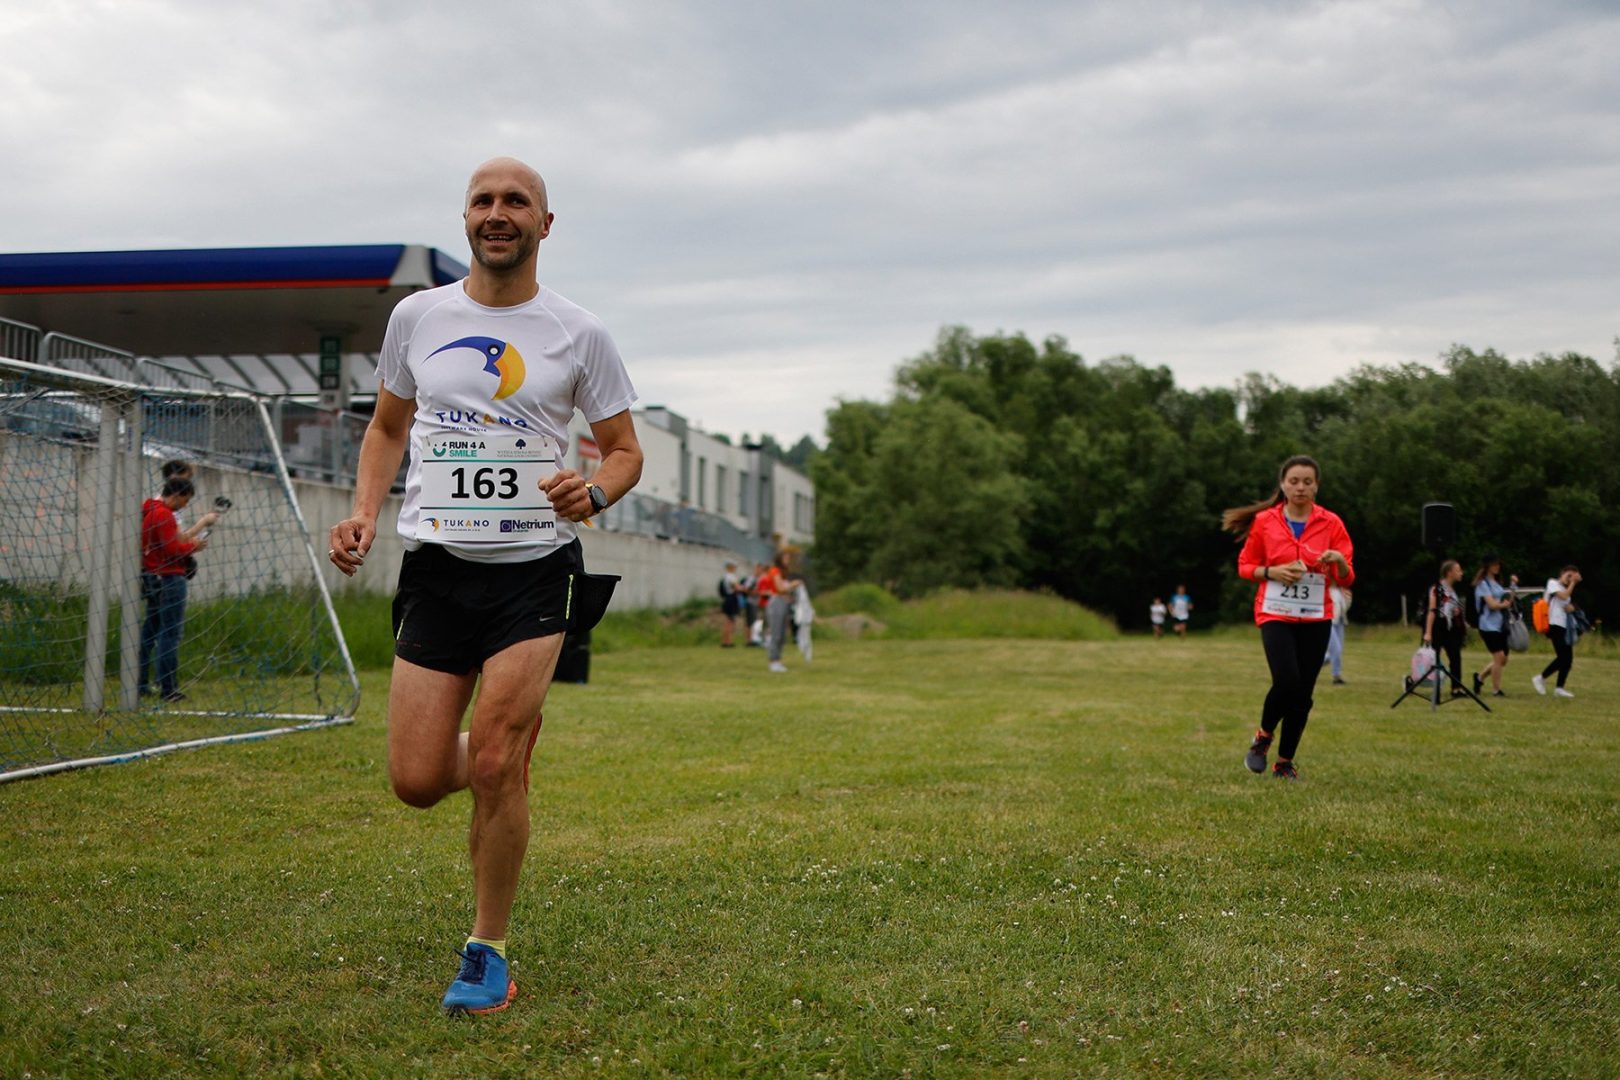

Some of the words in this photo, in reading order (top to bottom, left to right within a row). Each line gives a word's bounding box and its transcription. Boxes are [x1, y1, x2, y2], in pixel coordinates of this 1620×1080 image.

[435, 410, 527, 428] TUKANO
[449, 441, 468, 449] RUN
[470, 441, 477, 449] 4
[479, 441, 486, 449] A
[449, 450, 477, 458] SMILE
[451, 467, 519, 499] 163
[444, 519, 490, 527] TUKANO
[512, 519, 555, 530] Netrium
[1281, 583, 1310, 600] 213
